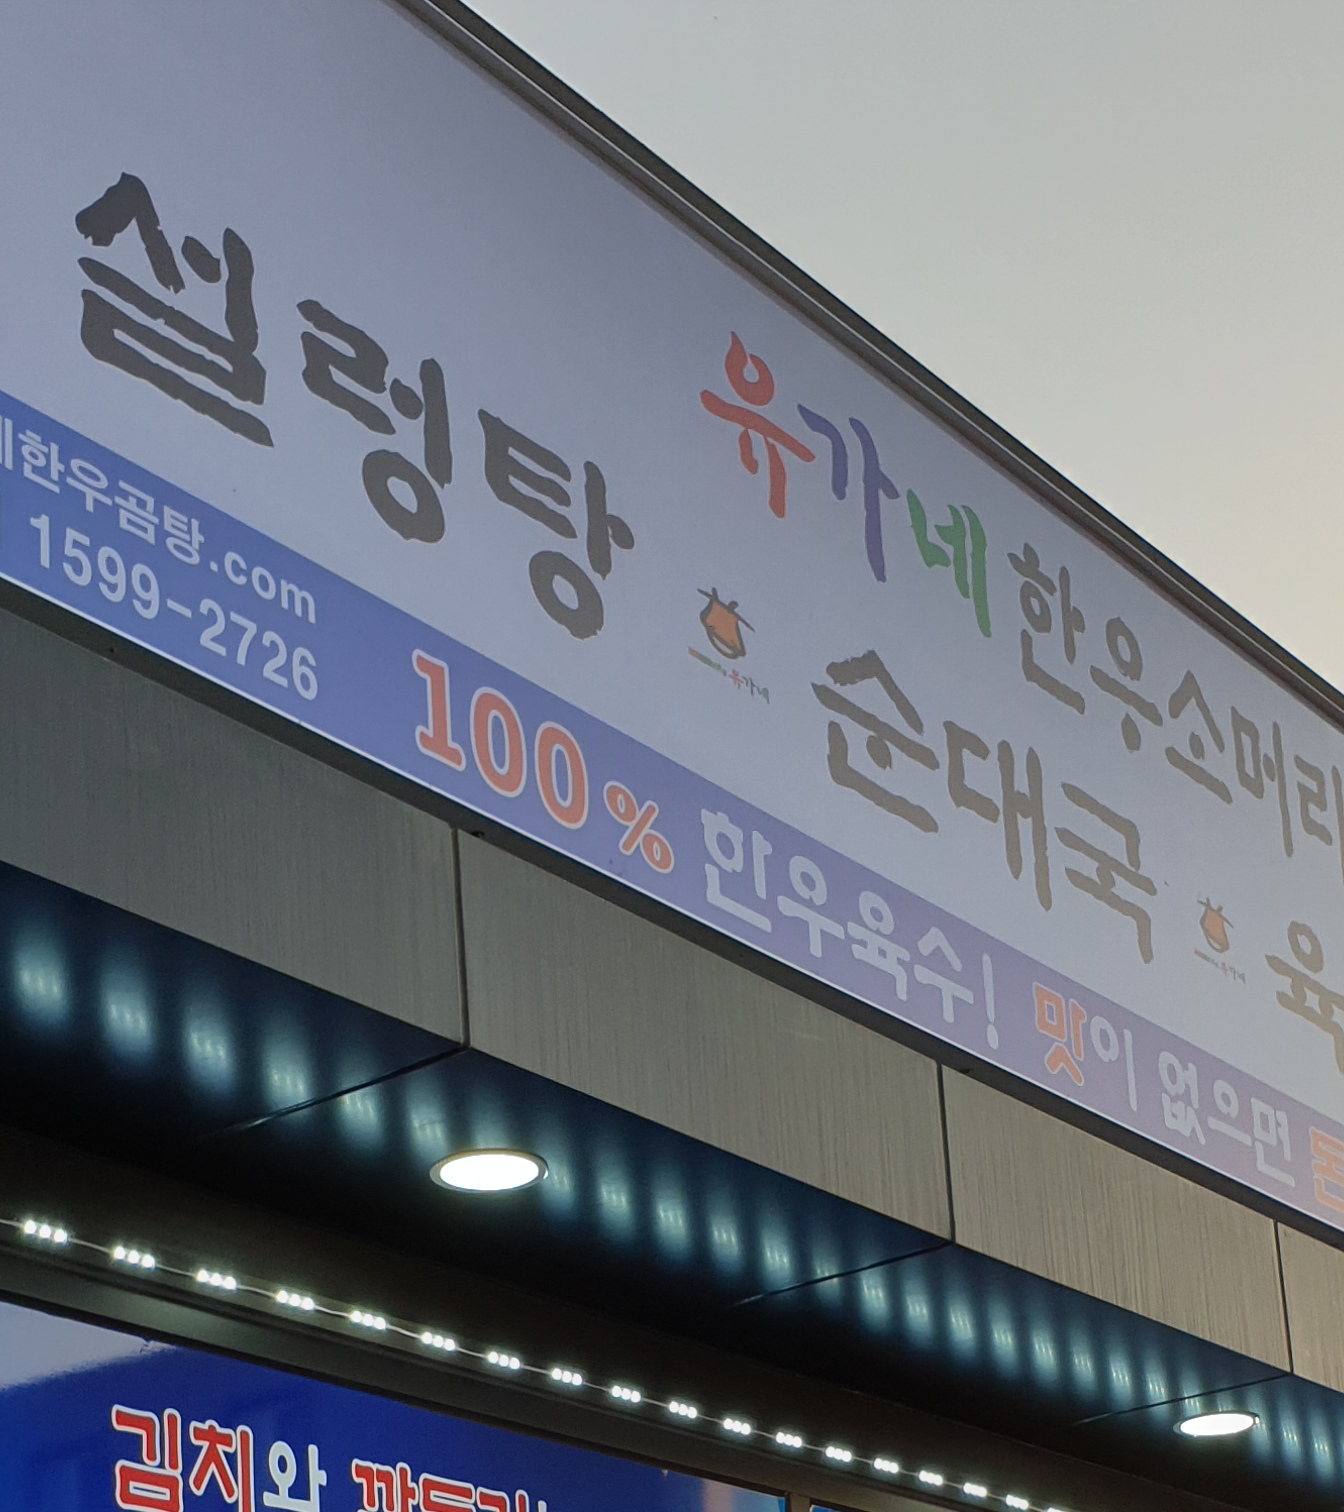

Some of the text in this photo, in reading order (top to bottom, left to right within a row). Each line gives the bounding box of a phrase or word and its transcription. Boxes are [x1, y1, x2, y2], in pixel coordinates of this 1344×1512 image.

[75, 172, 634, 641] 설렁탕
[30, 514, 319, 701] 1599-2726
[412, 649, 675, 874] 100%
[700, 808, 1001, 1050] 한우육수!
[1034, 981, 1138, 1112] 맛이
[1158, 1048, 1296, 1188] 없으면
[810, 649, 1157, 965] 순대국
